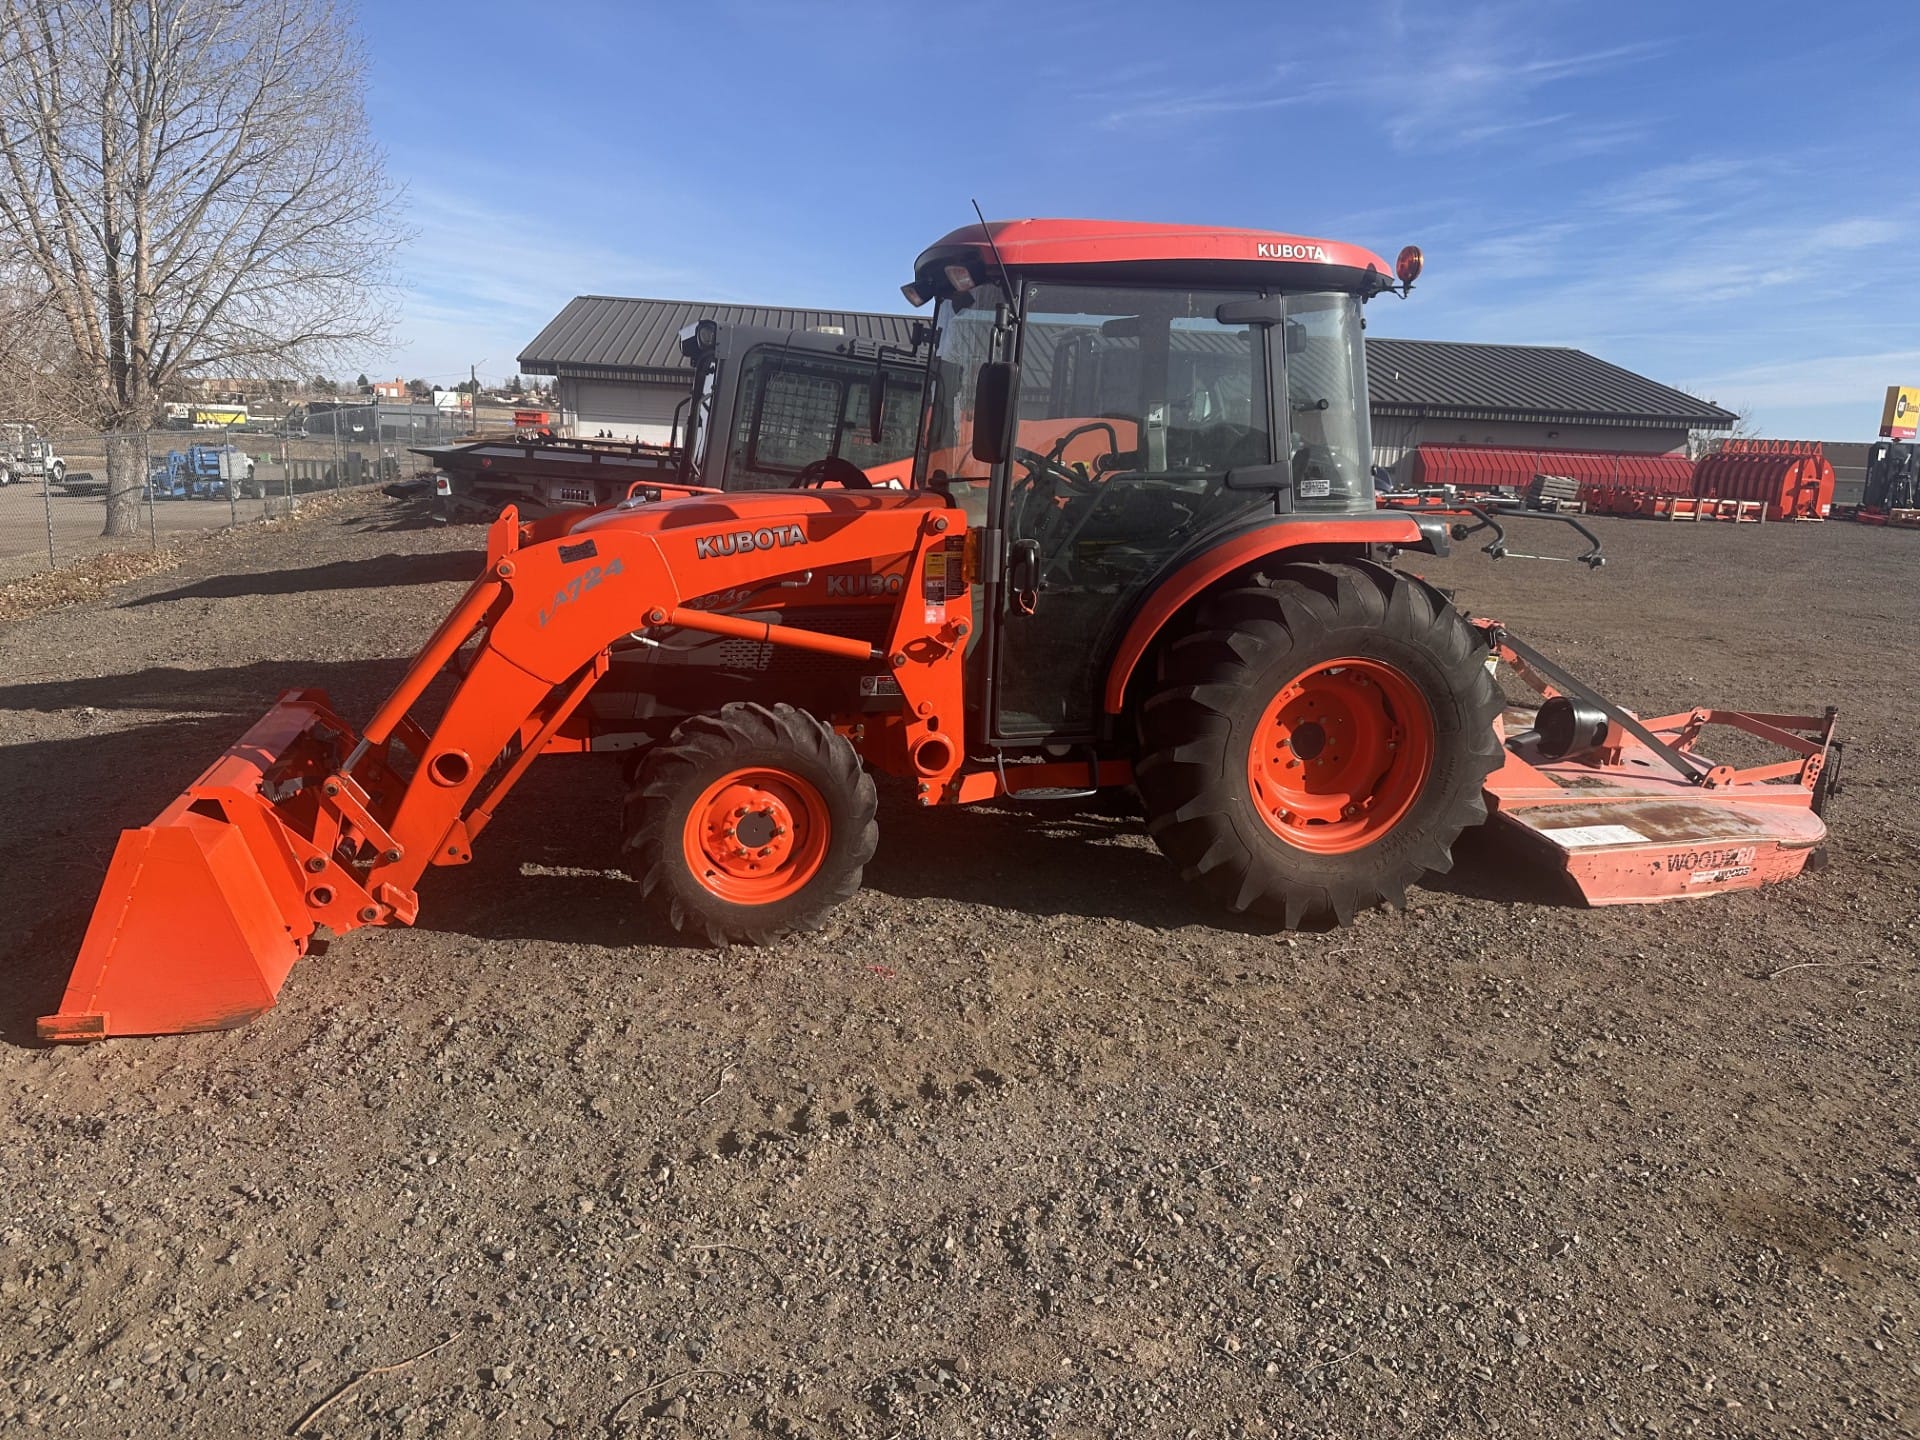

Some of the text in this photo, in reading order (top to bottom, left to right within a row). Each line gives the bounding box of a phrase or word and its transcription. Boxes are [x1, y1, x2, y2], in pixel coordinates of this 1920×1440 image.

[1257, 243, 1326, 260] KUBOTA
[696, 525, 808, 559] KUBOTA
[538, 557, 624, 628] LA724
